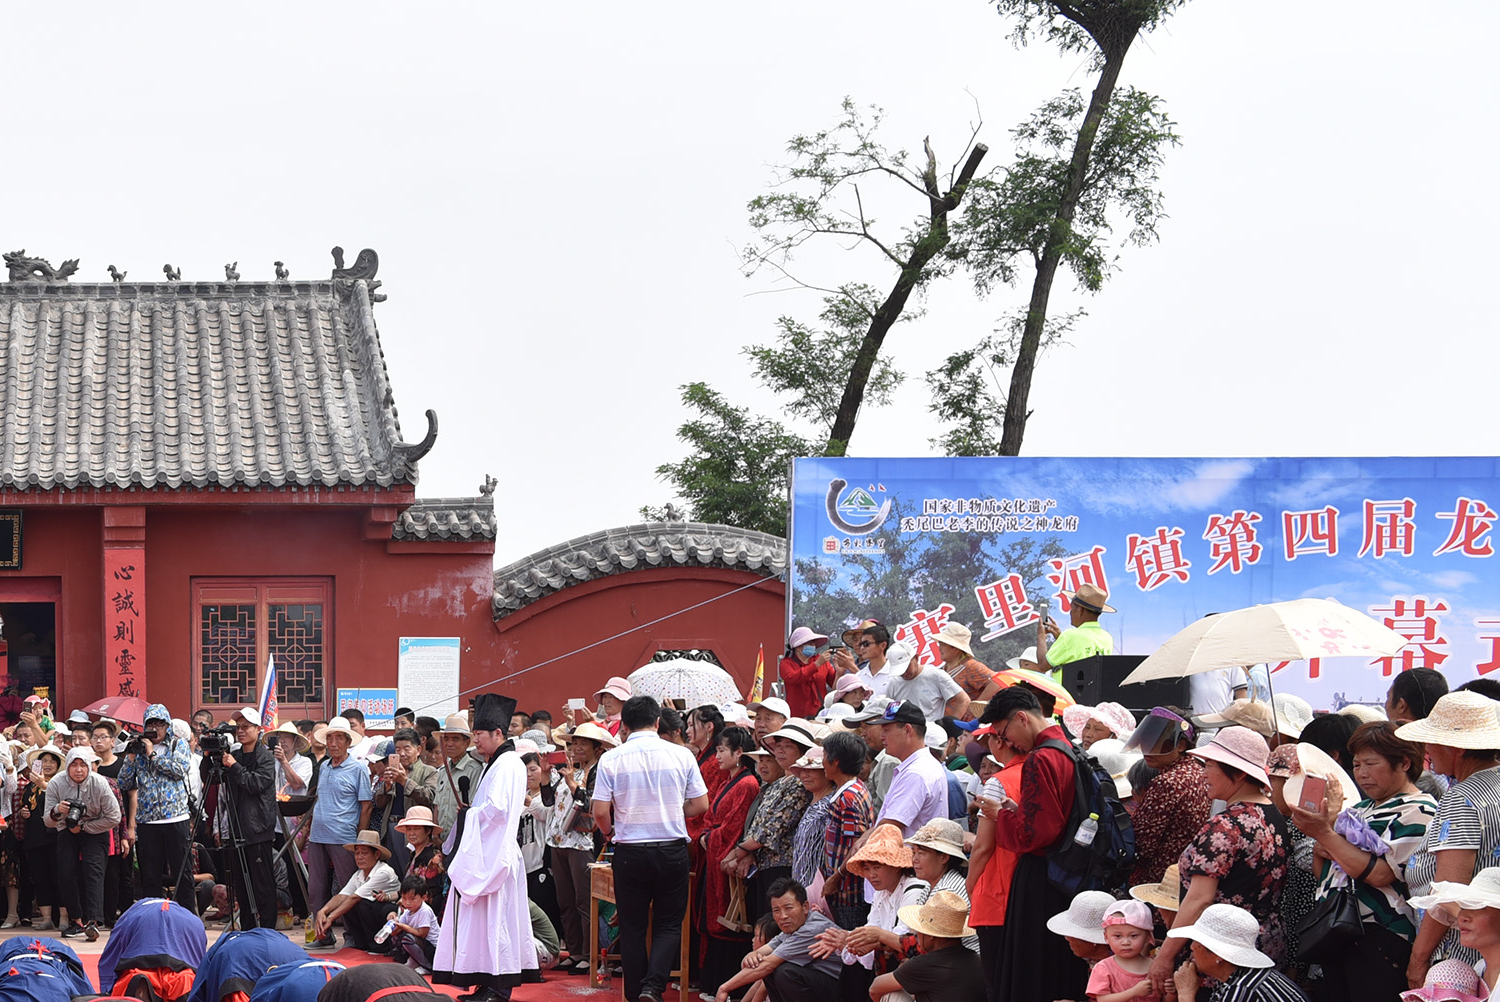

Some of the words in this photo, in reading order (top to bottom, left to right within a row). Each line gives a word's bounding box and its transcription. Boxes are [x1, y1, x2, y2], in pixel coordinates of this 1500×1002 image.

[923, 499, 1057, 514] 国家非物质文化遗产
[901, 516, 1079, 532] 秃尾巴老李的传说之神龙府
[112, 565, 140, 732] 心誠則靈感
